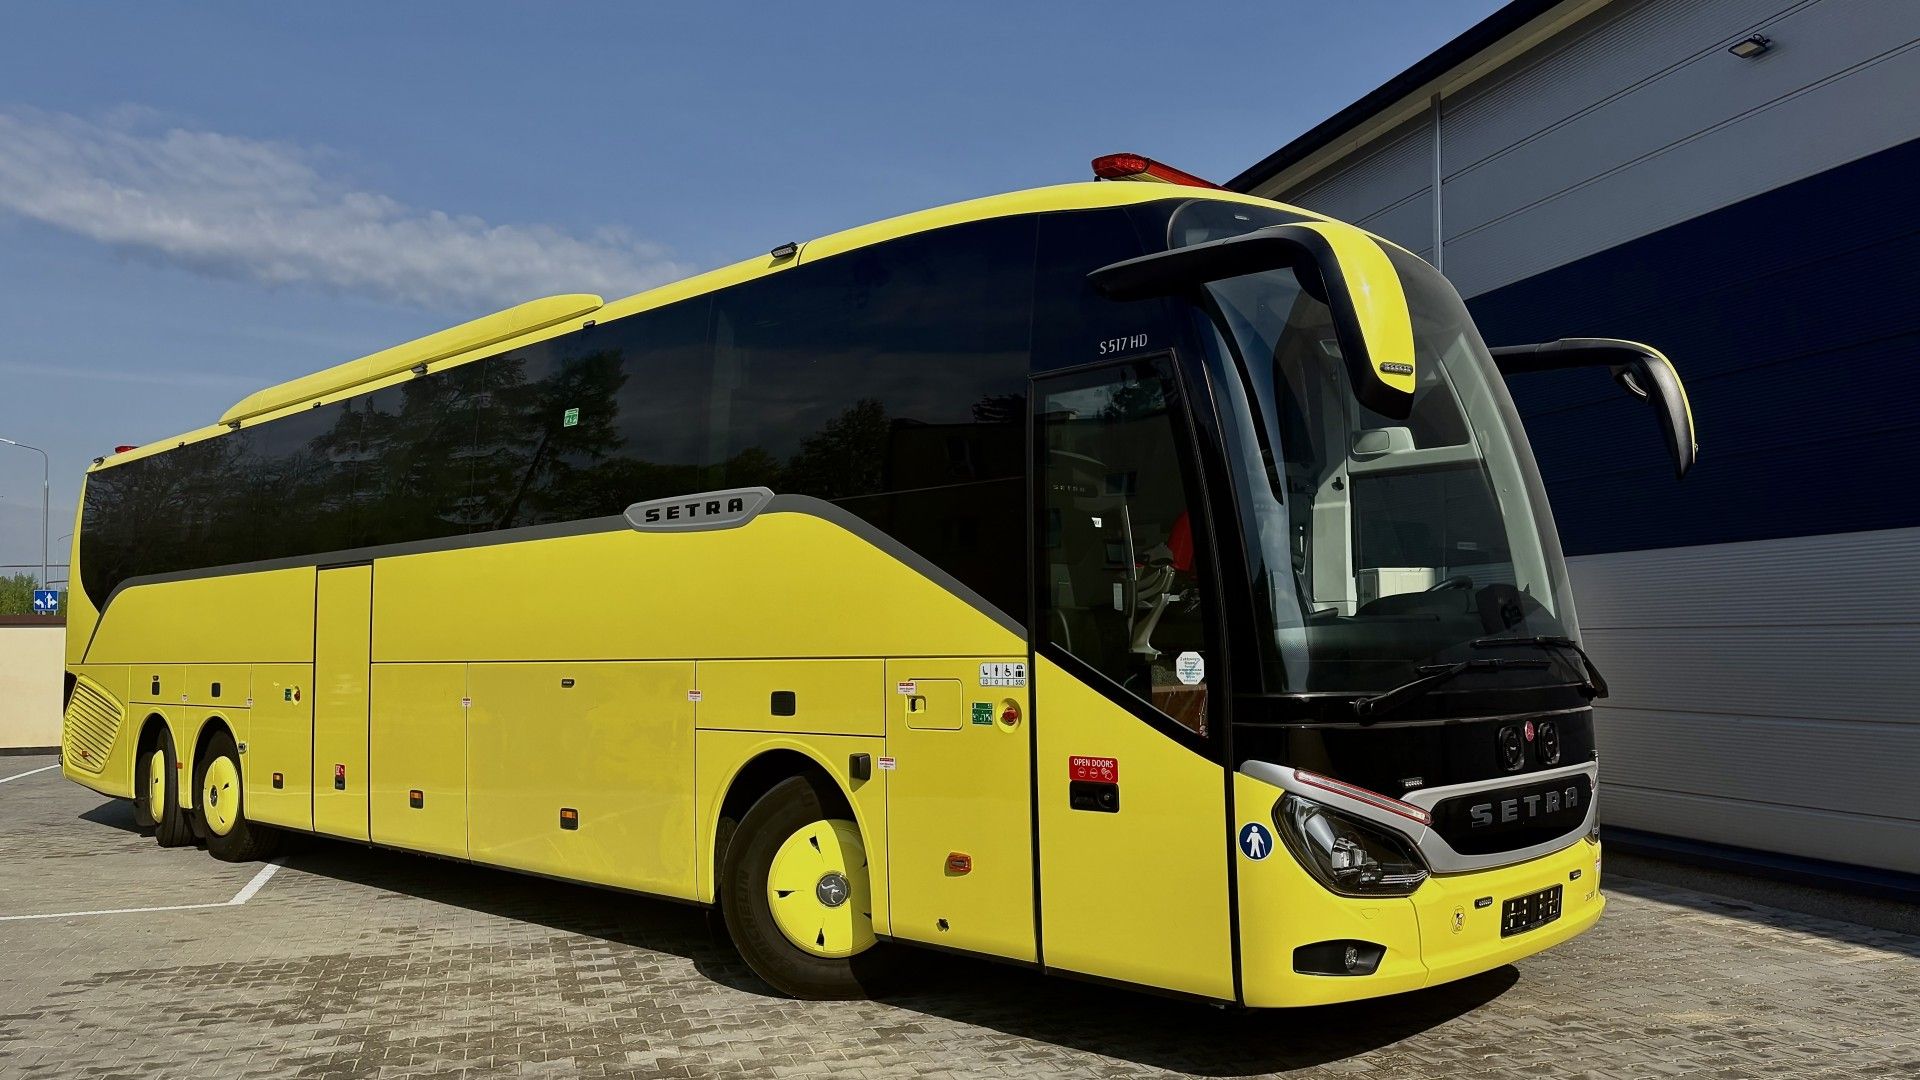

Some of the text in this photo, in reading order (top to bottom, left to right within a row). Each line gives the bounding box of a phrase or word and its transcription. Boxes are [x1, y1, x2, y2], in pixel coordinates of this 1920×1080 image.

[1100, 334, 1148, 354] S 517 HD
[645, 498, 744, 523] SETRA
[1073, 758, 1114, 769] OPEN DOORS
[1470, 786, 1578, 828] SETRA
